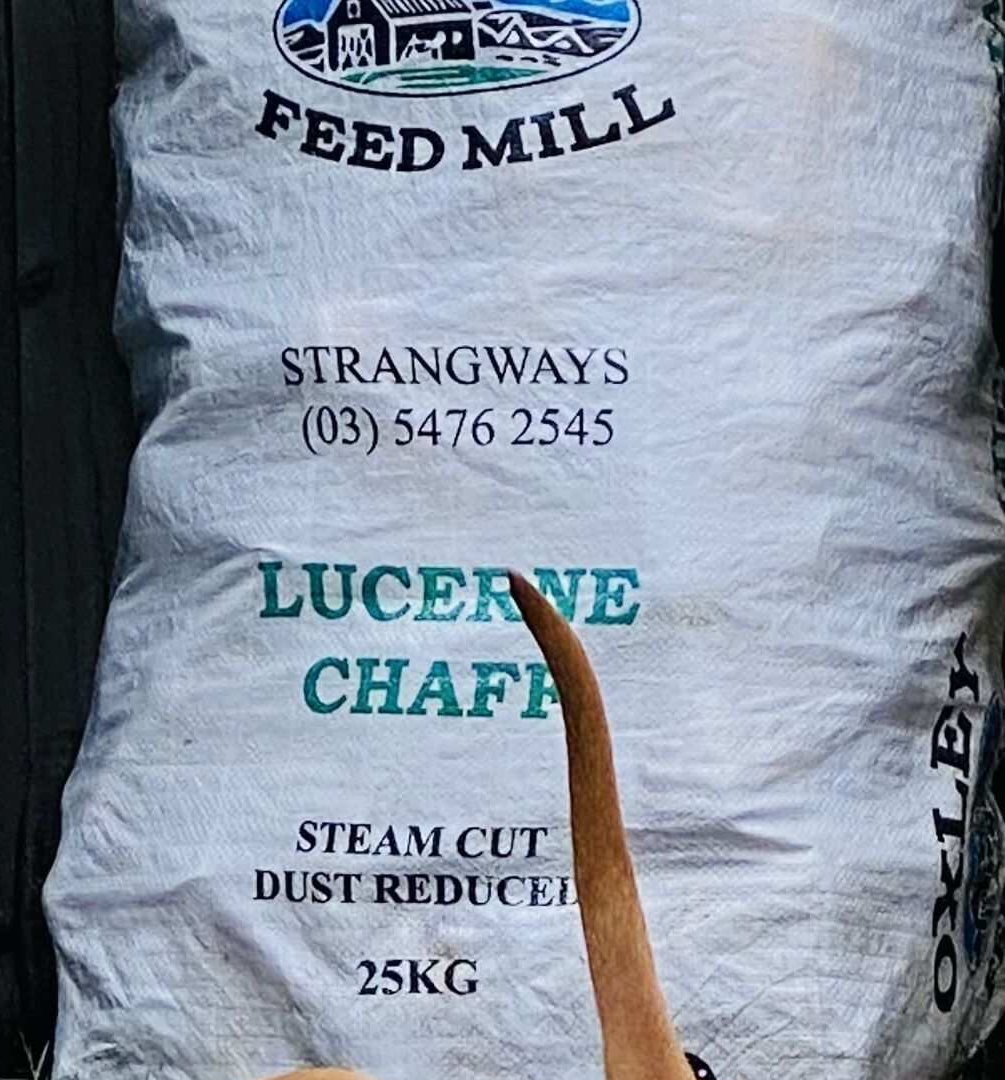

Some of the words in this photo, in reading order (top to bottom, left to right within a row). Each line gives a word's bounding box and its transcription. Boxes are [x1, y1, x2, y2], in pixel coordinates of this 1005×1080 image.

[254, 89, 445, 172] FEED
[462, 83, 676, 170] MILL
[281, 345, 629, 386] STRANGWAYS
[302, 405, 379, 455] (03)
[394, 407, 495, 447] 5476
[511, 407, 614, 446] 2545
[257, 561, 641, 626] LUCERNE
[296, 820, 445, 858] STEAM
[456, 826, 548, 859] CUT
[253, 869, 362, 904] DUST
[357, 959, 479, 996] 25KG
